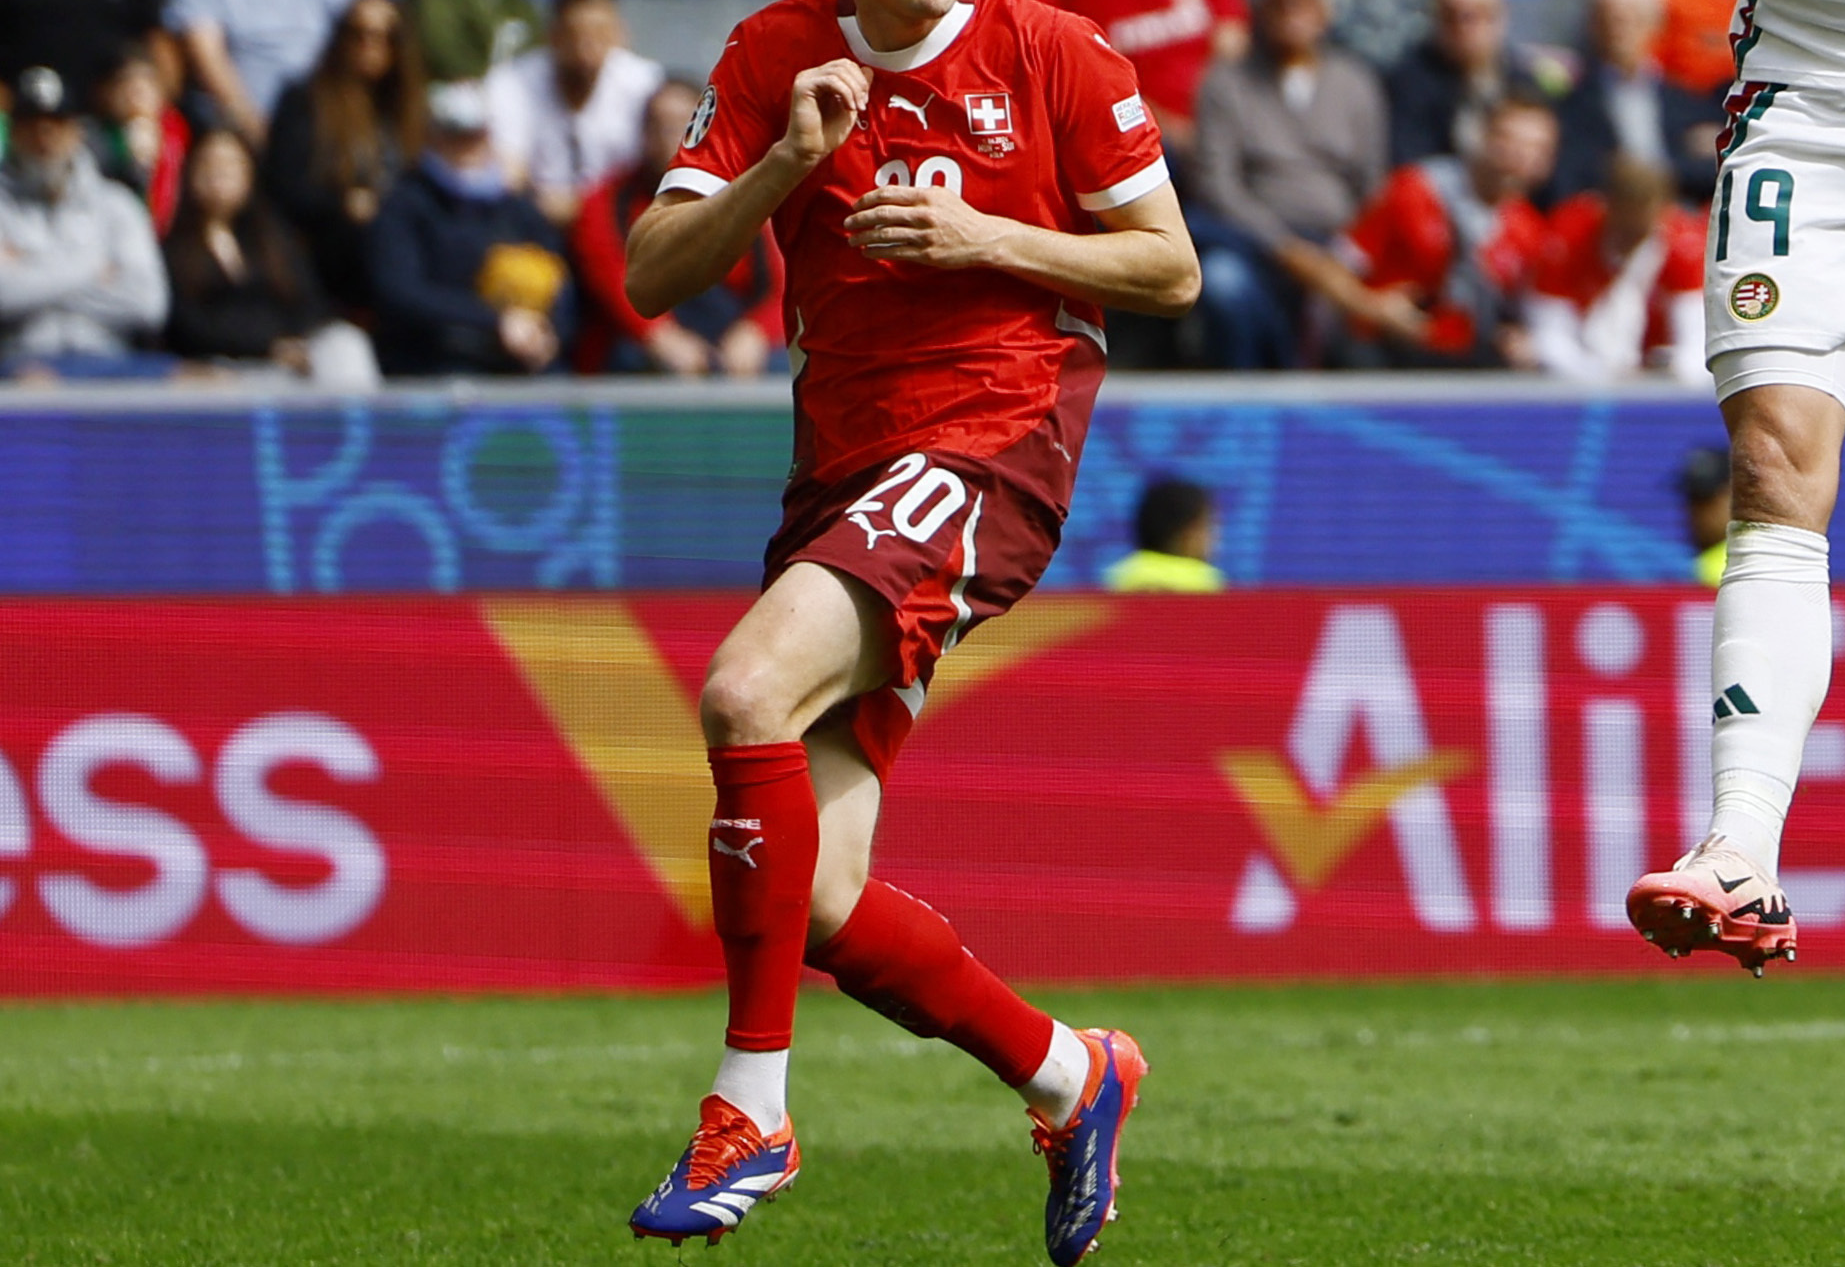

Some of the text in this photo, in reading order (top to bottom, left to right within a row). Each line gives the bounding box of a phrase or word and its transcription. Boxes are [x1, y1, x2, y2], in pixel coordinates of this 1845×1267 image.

[1715, 168, 1794, 262] 19
[845, 452, 966, 543] 20
[0, 705, 388, 946] ss
